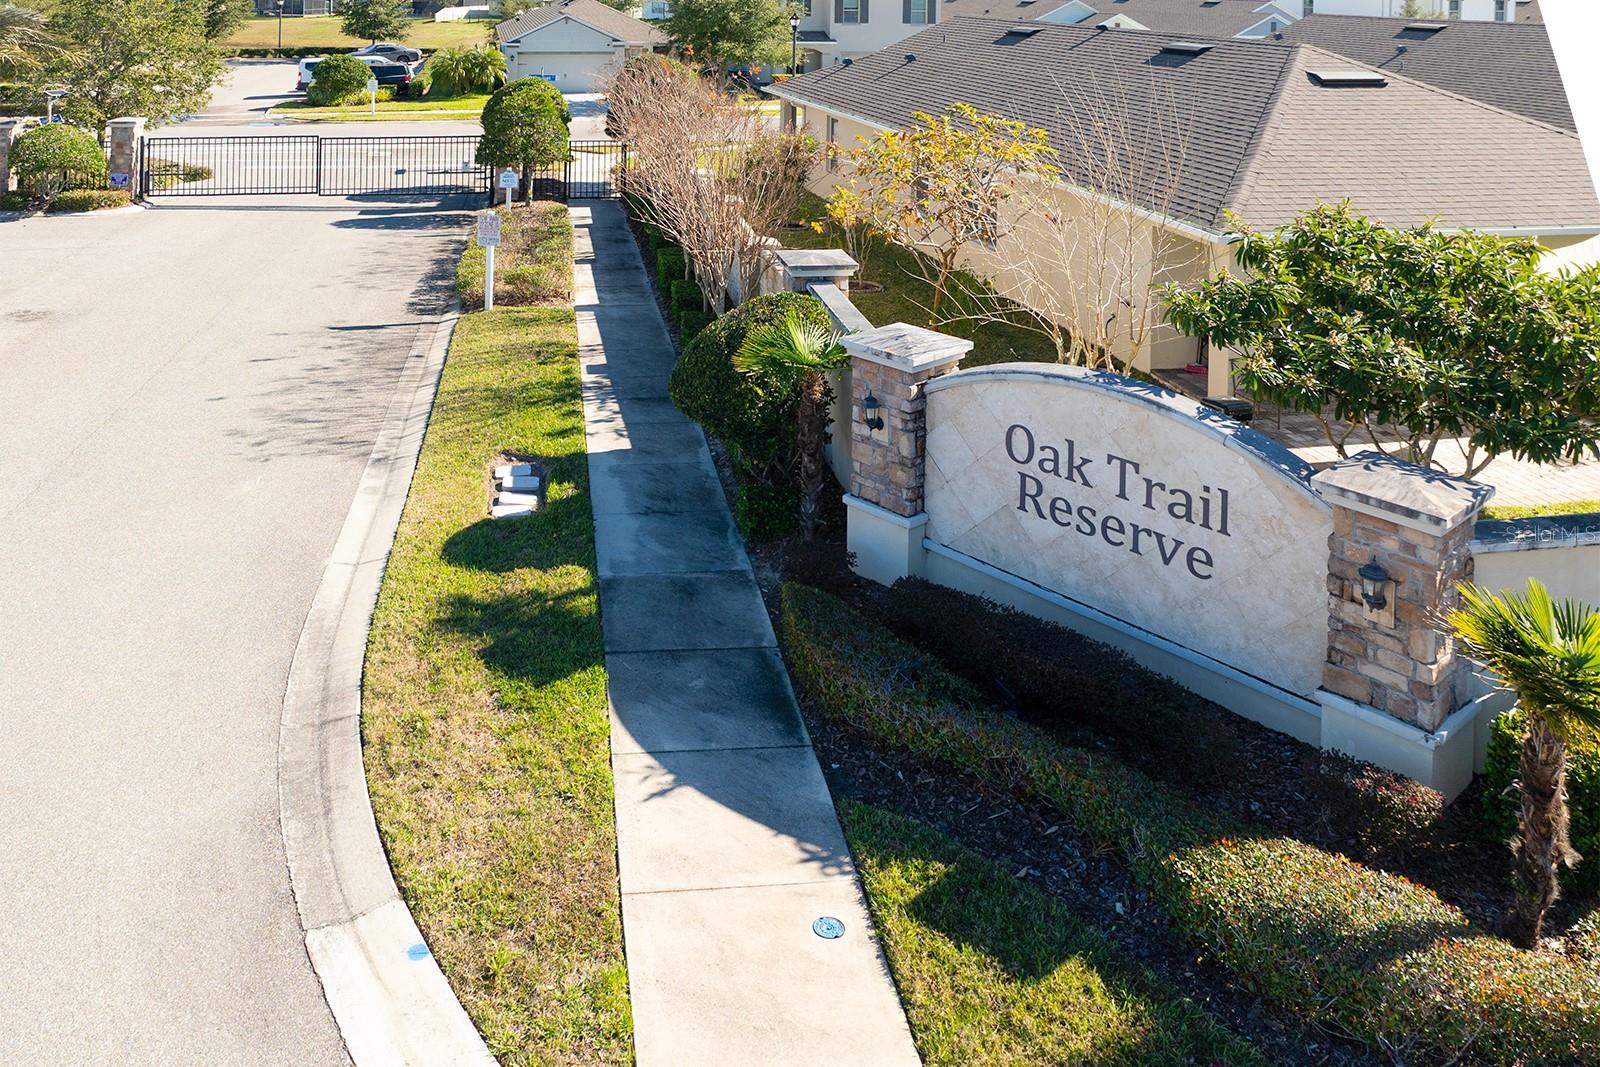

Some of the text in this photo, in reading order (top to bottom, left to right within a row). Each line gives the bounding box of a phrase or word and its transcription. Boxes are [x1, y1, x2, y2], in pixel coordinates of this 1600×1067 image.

[1005, 424, 1231, 537] Oak Trail
[1016, 471, 1214, 580] Reserve
